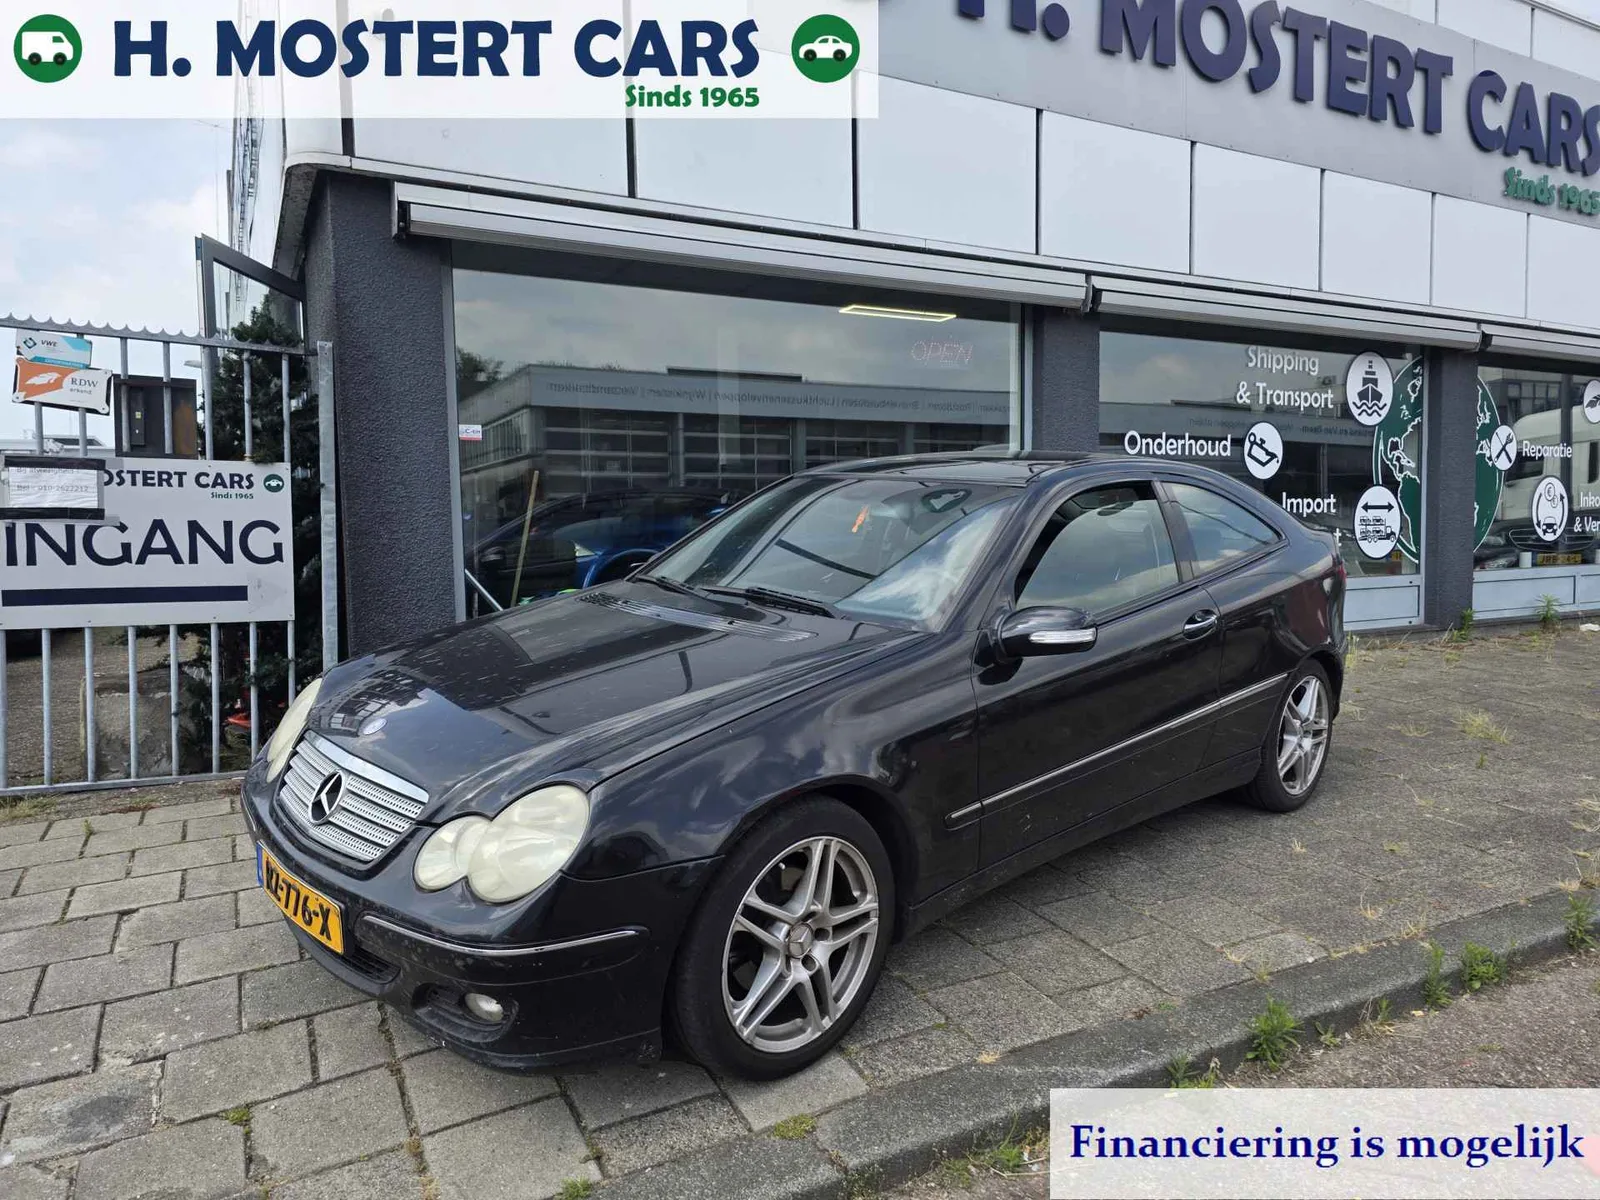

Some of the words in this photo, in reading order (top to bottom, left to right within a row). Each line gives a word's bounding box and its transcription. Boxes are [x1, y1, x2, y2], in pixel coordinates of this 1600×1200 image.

[1100, 0, 1453, 134] MOSTERT
[1466, 70, 1600, 176] CARS
[1503, 166, 1556, 205] Sinds
[1558, 182, 1600, 215] 1965
[41, 339, 57, 347] VWE
[911, 340, 974, 362] OPEN
[1247, 346, 1320, 376] Shipping
[71, 377, 98, 387] RDW
[1236, 381, 1250, 404] &
[1256, 382, 1334, 410] Transport
[1124, 430, 1231, 456] Onderhoud
[1522, 440, 1572, 462] Reparatie
[194, 472, 254, 490] CARS
[1282, 491, 1336, 518] Import
[1574, 516, 1582, 532] &
[5, 518, 284, 567] INGANG
